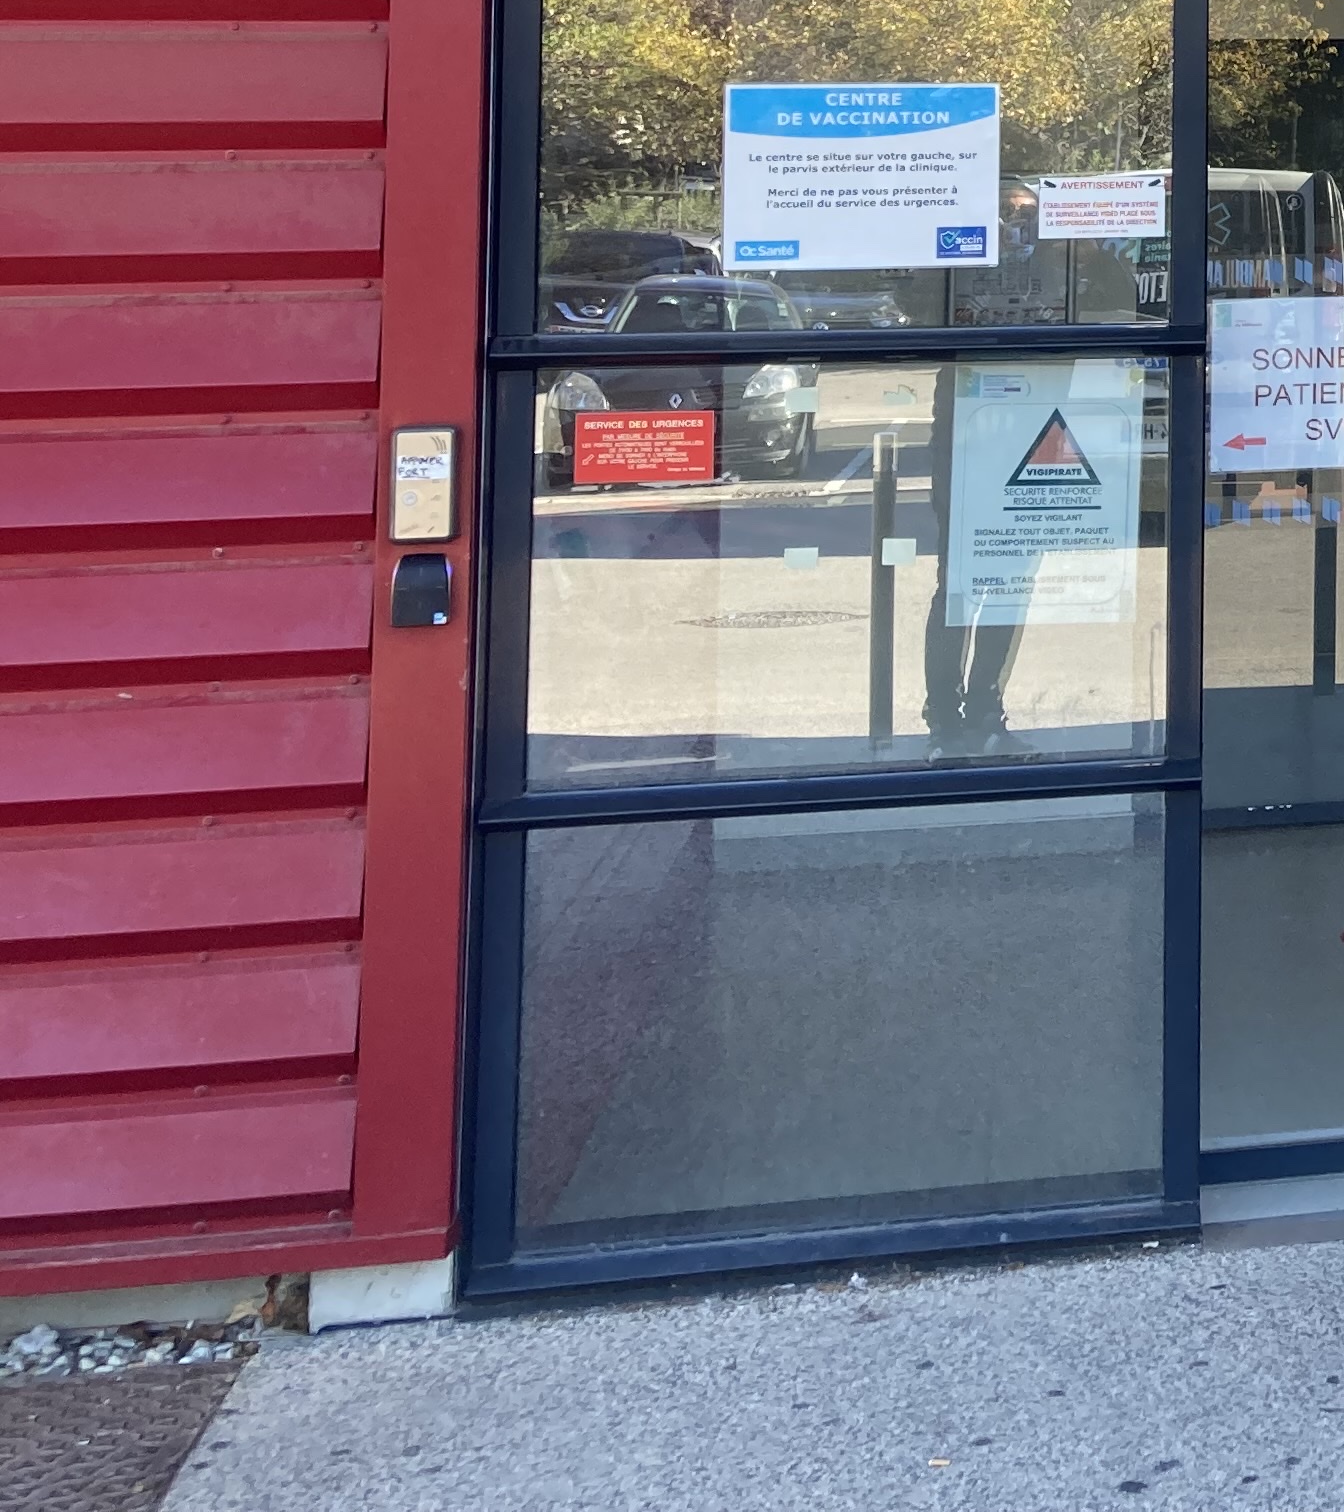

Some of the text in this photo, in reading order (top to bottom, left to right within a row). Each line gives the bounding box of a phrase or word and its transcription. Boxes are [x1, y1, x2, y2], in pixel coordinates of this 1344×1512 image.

[825, 93, 902, 107] CENTRE
[777, 111, 950, 126] DE VACCINATION
[749, 153, 762, 162] Le
[766, 153, 803, 162] centre
[807, 154, 819, 162] se
[823, 152, 851, 162] situe
[855, 153, 873, 161] sur
[877, 152, 906, 161] votre
[959, 152, 977, 160] sur
[768, 165, 778, 173] le
[782, 164, 818, 175] parvis
[822, 163, 875, 173] extérieur
[878, 164, 892, 172] de
[896, 164, 905, 172] la
[1061, 181, 1144, 189] AVERTISSEMENT
[768, 188, 799, 197] Merci
[803, 188, 817, 196] de
[838, 188, 858, 198] pas
[892, 186, 948, 196] présenter
[817, 199, 831, 208] du
[835, 199, 876, 208] service
[880, 198, 899, 207] des
[584, 421, 624, 430] SERVICE
[653, 420, 703, 428] URGENCES
[1026, 468, 1082, 476] VIGIPIRATE
[1004, 487, 1046, 496] SECURITE
[1013, 496, 1093, 505] RISQUE ATTENTAT
[1045, 514, 1082, 522] VIGILANT
[1075, 527, 1109, 535] PAQUET
[973, 549, 1024, 557] PERSONNEL
